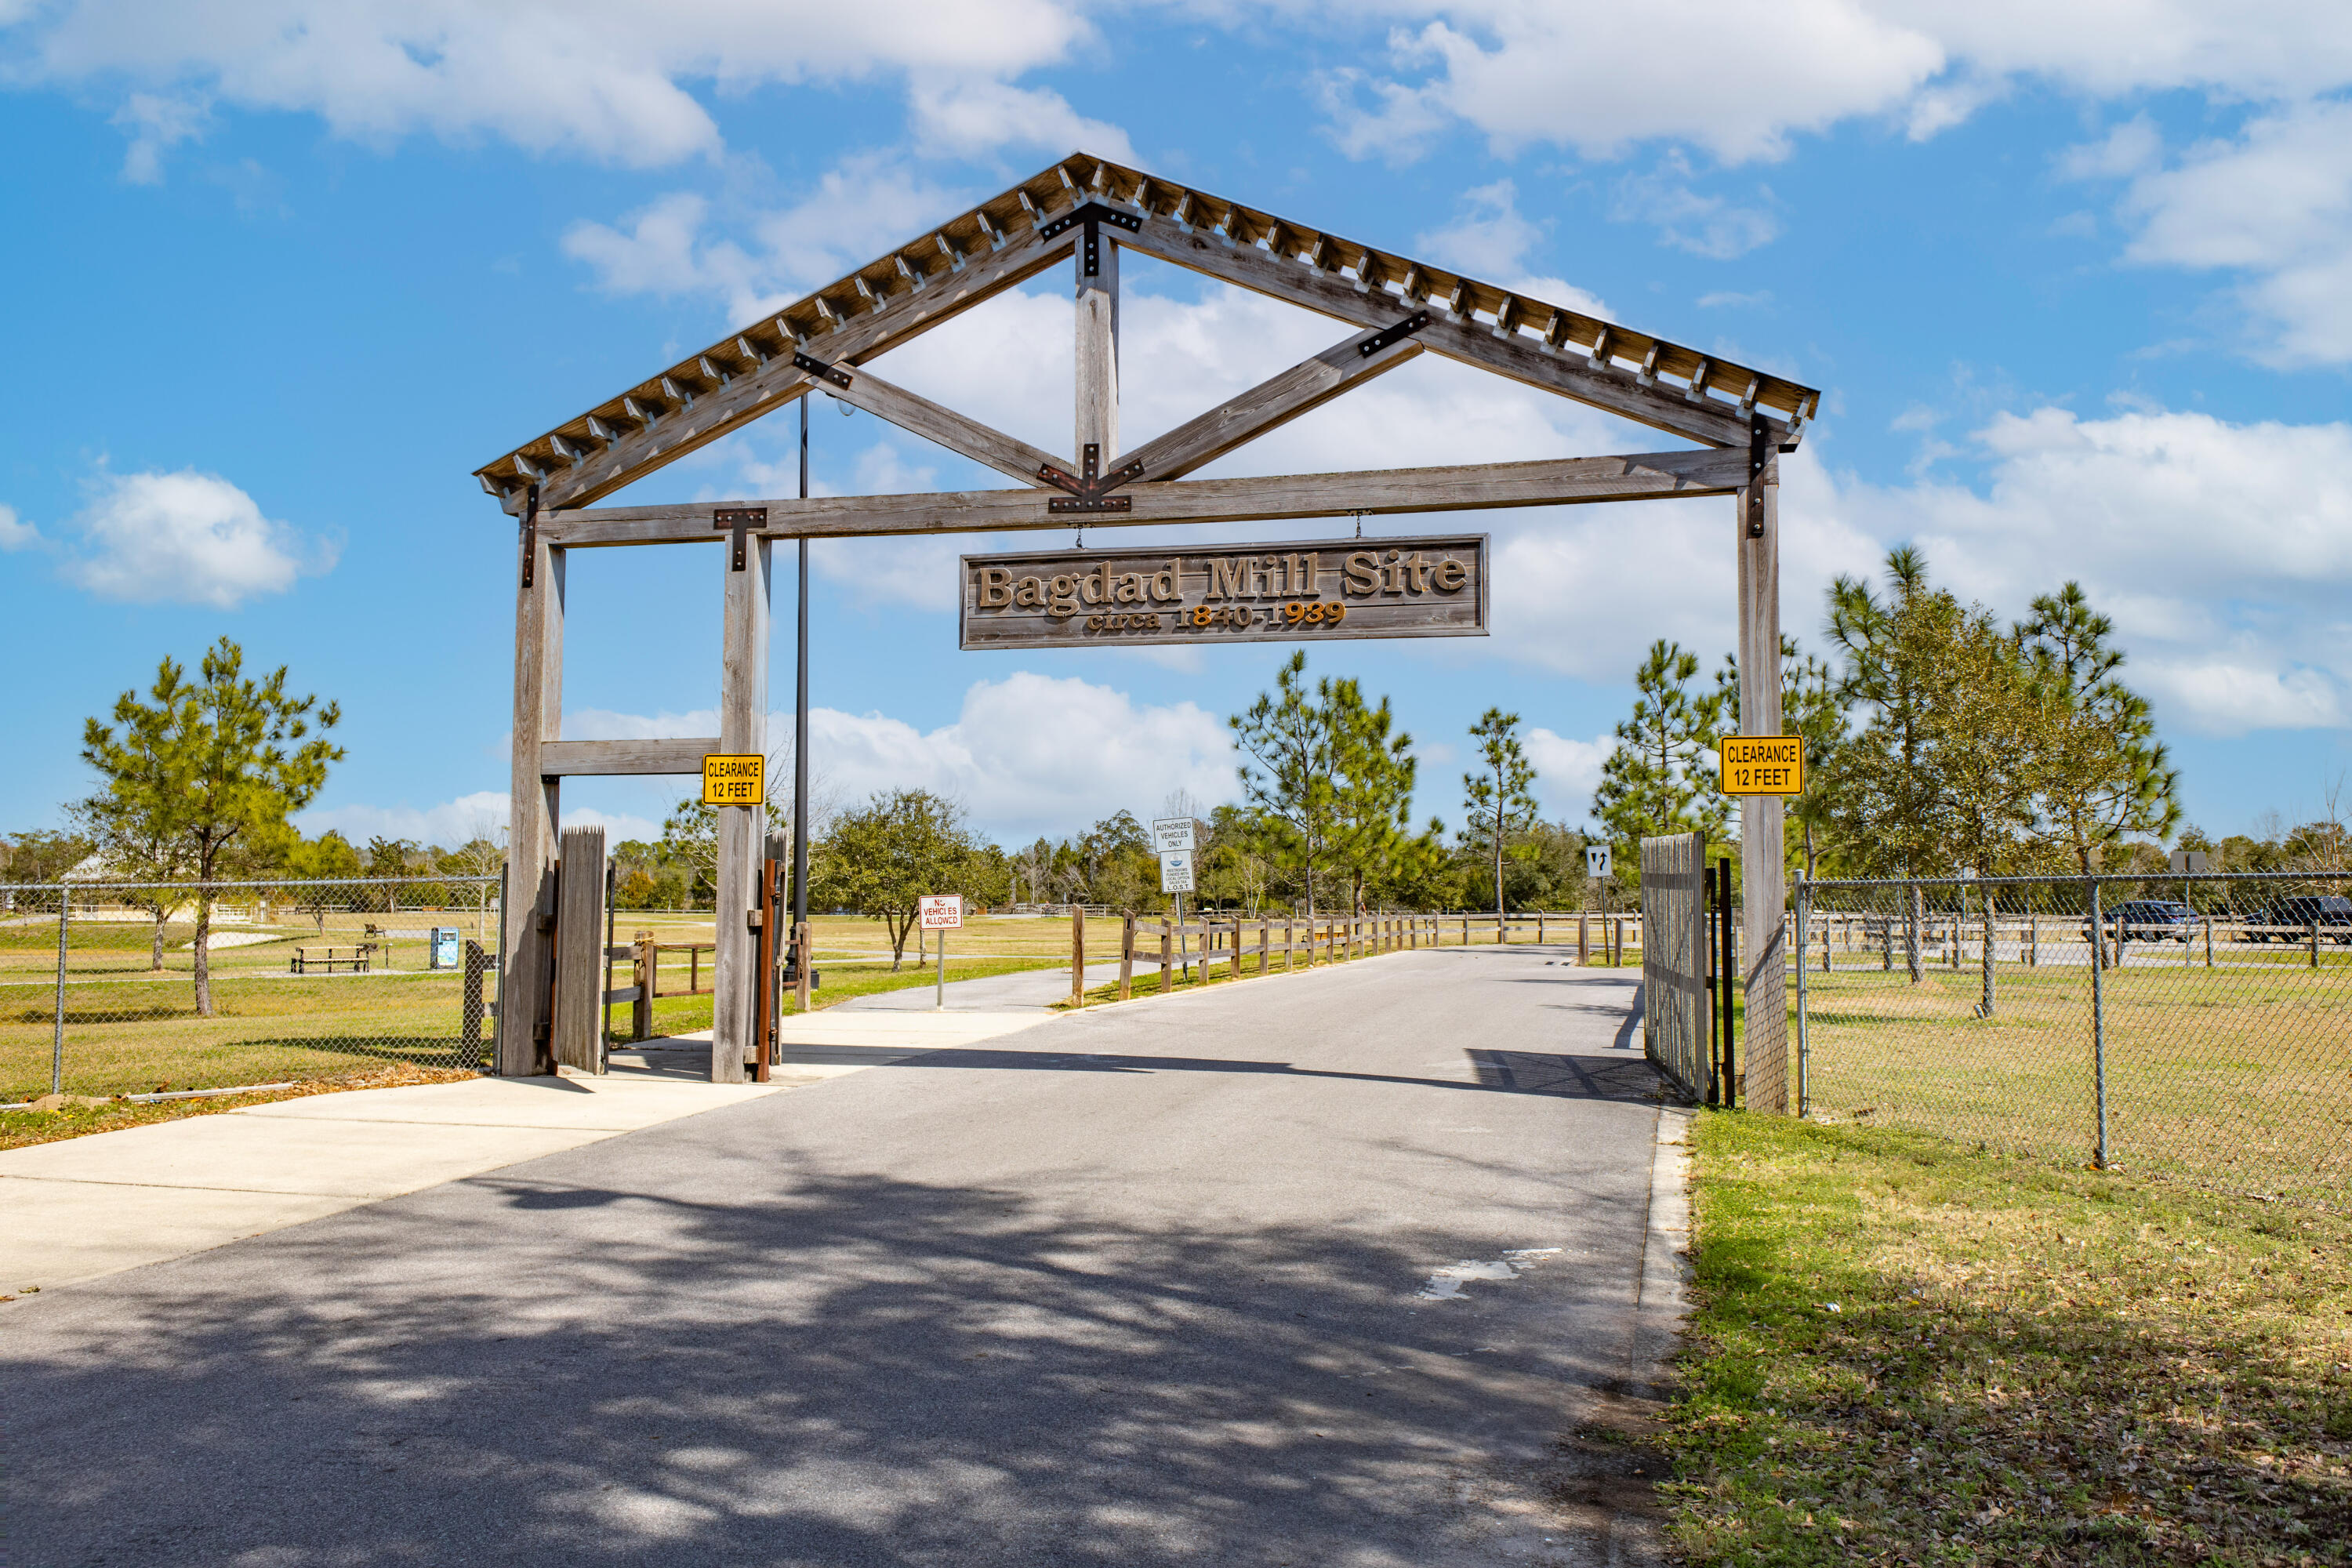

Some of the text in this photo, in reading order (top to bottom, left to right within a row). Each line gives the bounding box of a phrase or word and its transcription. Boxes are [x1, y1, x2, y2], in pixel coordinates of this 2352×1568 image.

[978, 549, 1468, 618] Bagdad Mill Site
[1087, 601, 1347, 630] circa 1840-1939
[1728, 745, 1796, 763] CLEARANCE
[708, 762, 759, 777] CLEARANCE
[1734, 768, 1791, 786] 12 FEET
[712, 782, 754, 797] 12 FEET
[1156, 822, 1191, 831] AUTHORIZED
[1160, 831, 1188, 840] VEHICLES
[924, 906, 957, 916] VEHICLES
[925, 916, 958, 925] ALLOWED
